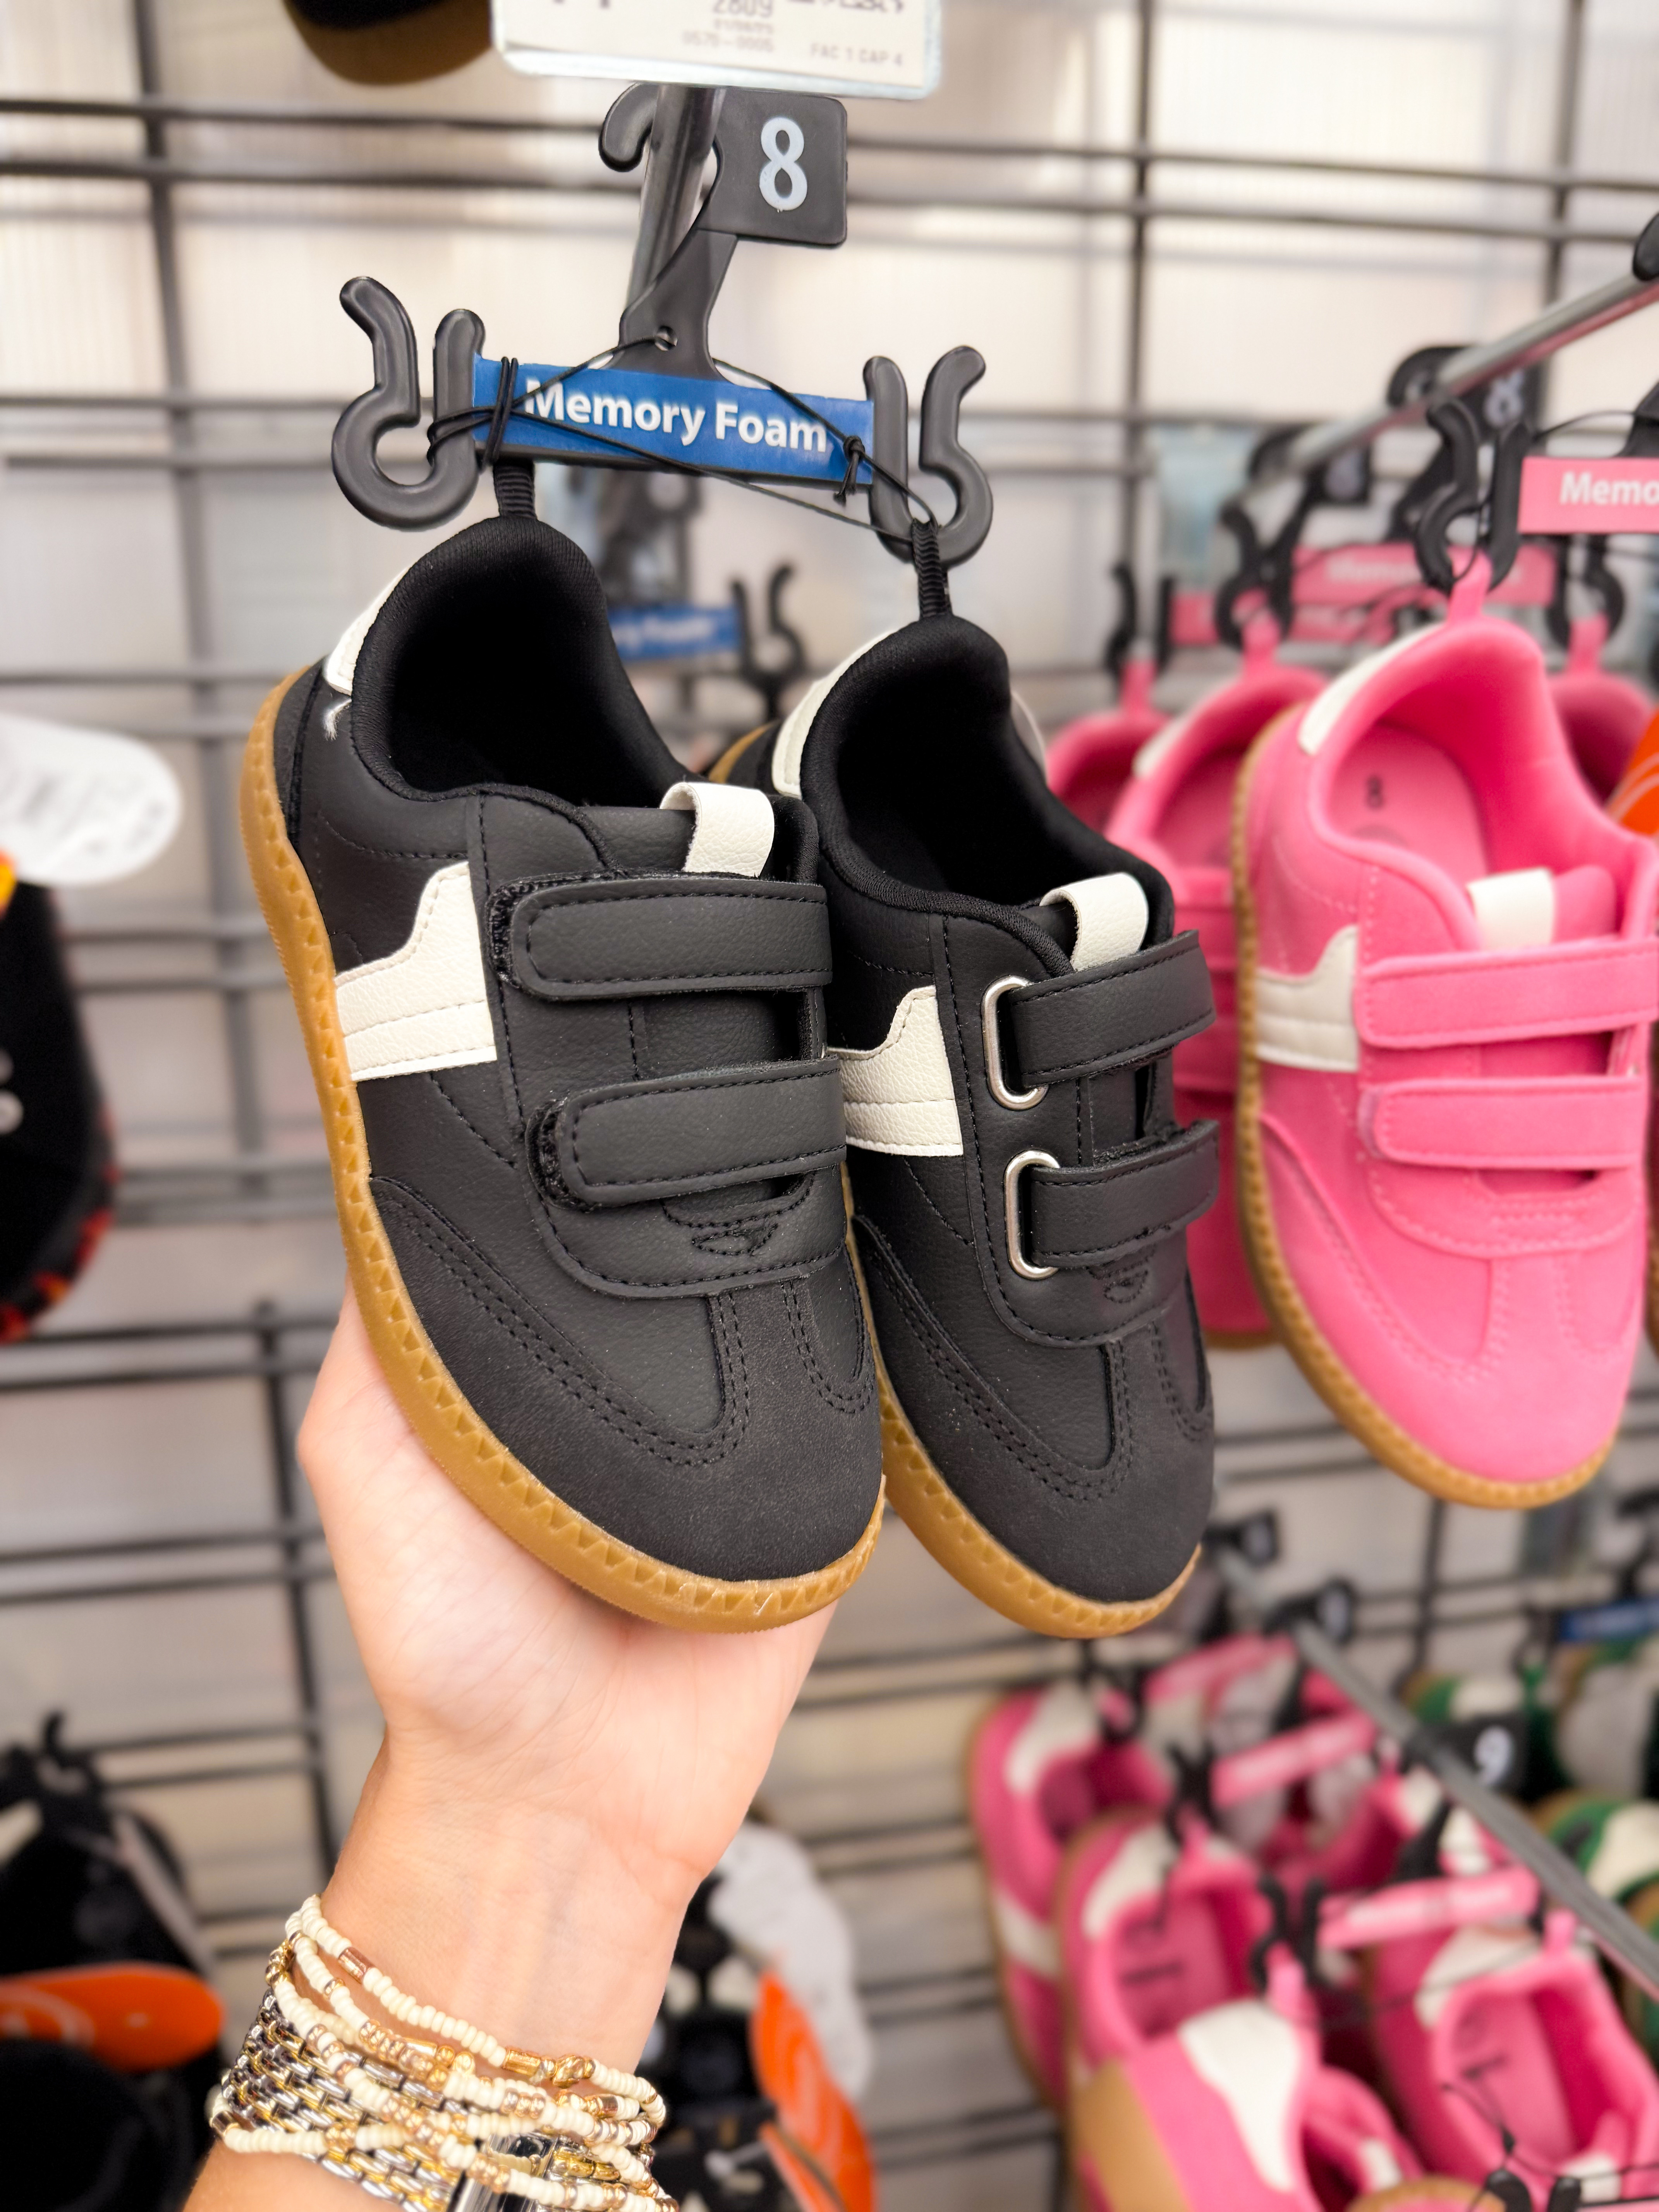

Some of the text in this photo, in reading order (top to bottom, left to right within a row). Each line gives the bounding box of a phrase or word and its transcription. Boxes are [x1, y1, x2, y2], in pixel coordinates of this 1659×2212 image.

[810, 43, 839, 60] FAC
[859, 48, 889, 64] CAP
[894, 53, 903, 66] 4
[759, 116, 807, 211] 8
[525, 378, 826, 452] Memory Foam
[1560, 471, 1659, 505] Memo
